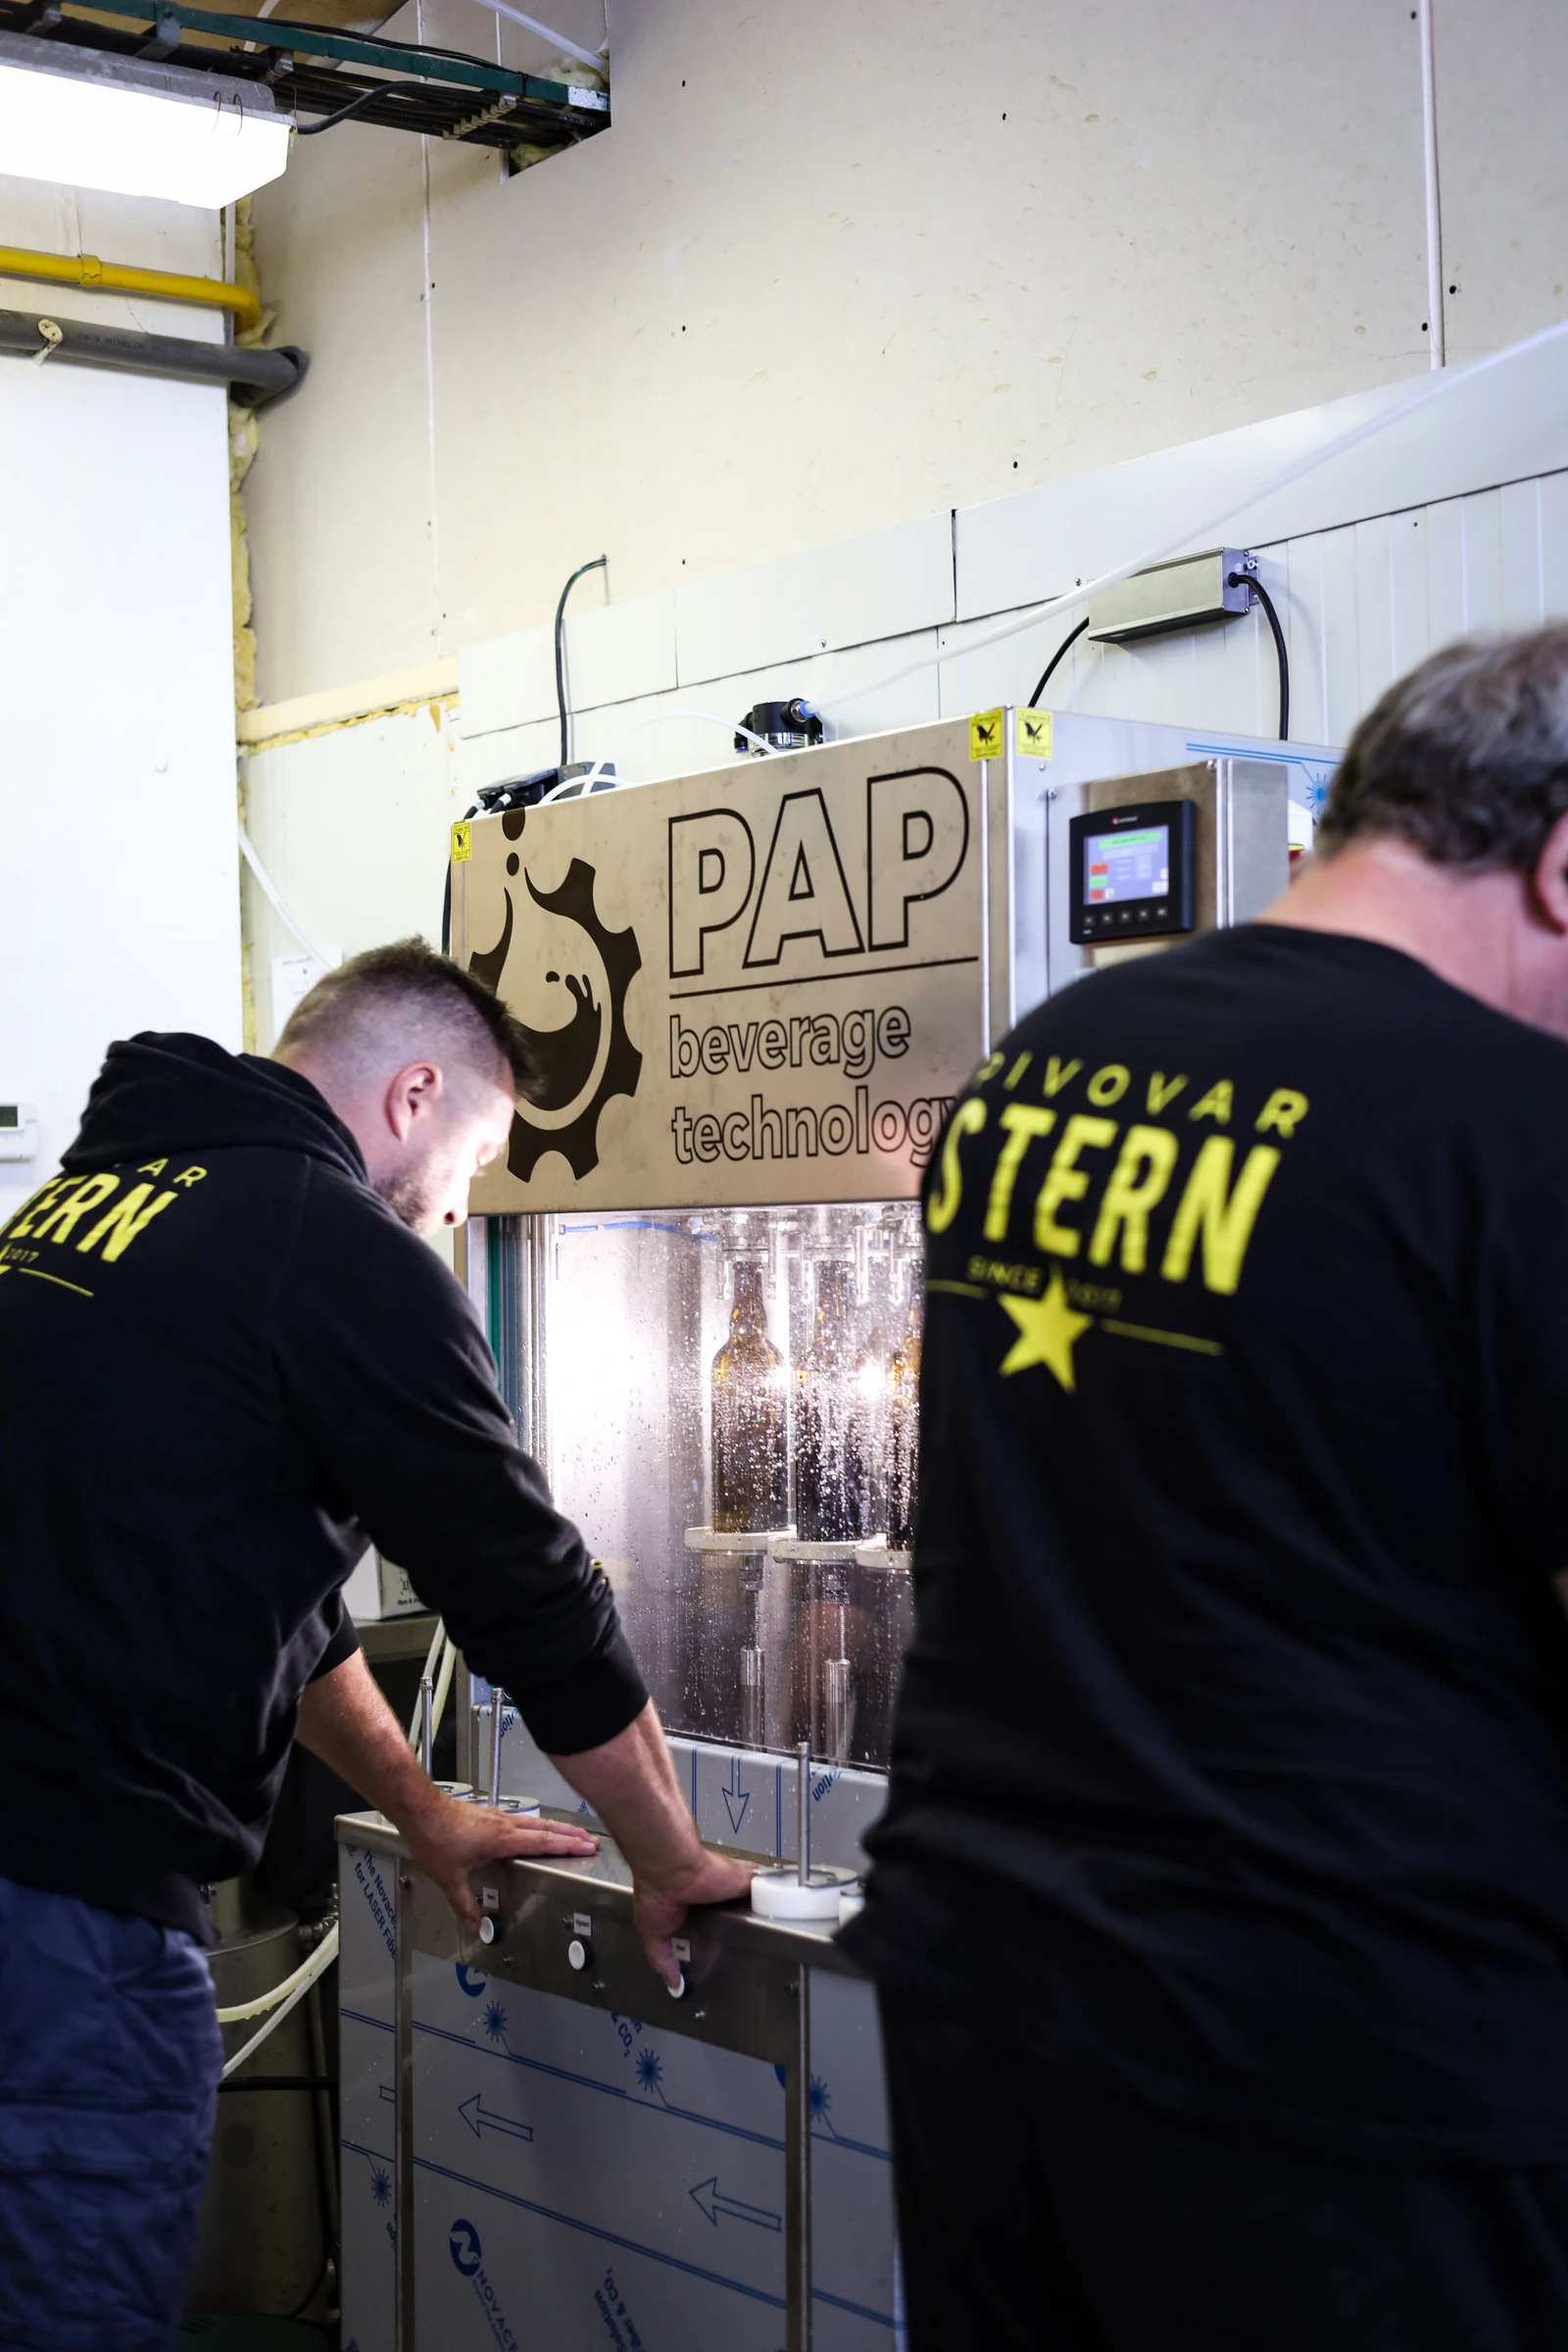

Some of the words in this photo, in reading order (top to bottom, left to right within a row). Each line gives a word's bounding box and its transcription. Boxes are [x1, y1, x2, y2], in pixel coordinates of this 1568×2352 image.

[667, 765, 969, 978] PAP
[669, 1005, 911, 1079] beverage
[926, 1098, 1282, 1296] STERN
[355, 1862, 366, 1884] for
[364, 1883, 385, 1930] LASER
